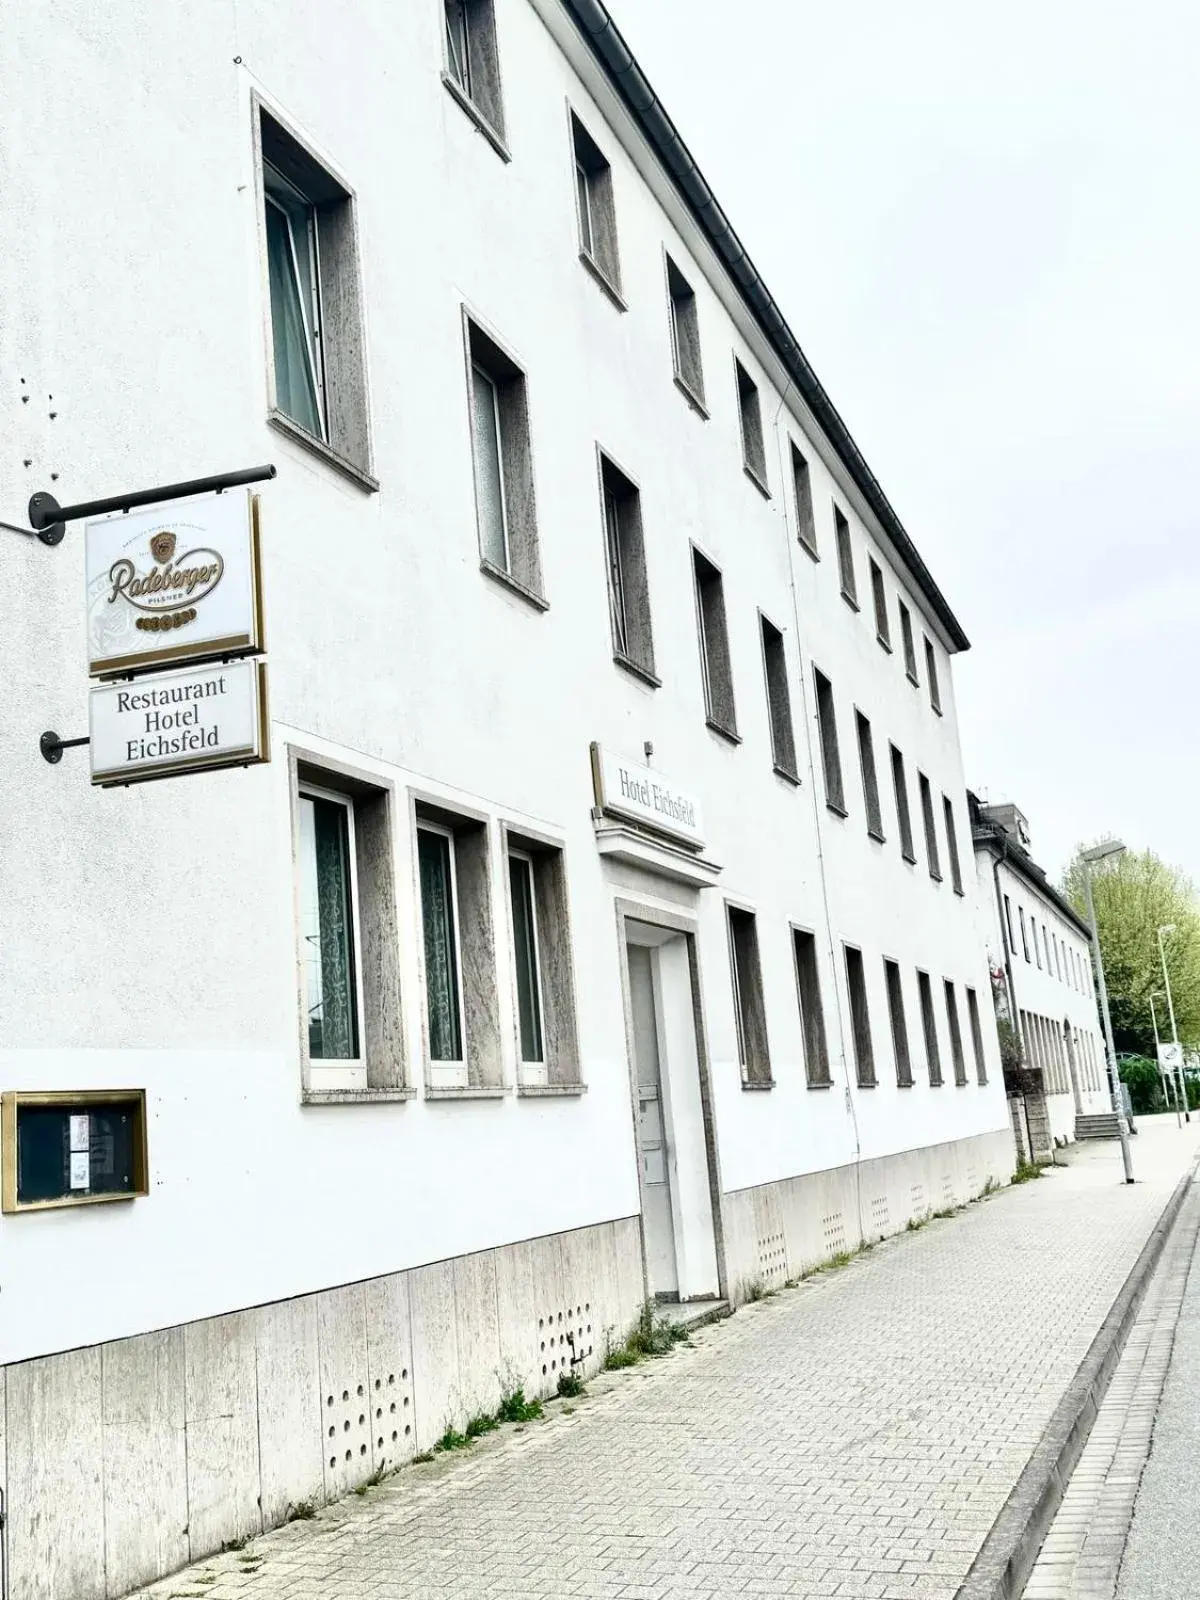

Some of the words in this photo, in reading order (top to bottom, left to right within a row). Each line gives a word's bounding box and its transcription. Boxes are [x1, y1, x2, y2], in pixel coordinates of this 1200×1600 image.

[108, 556, 220, 604] Radeberger
[148, 593, 183, 604] PILSNER
[117, 674, 226, 713] Restaurant
[144, 704, 199, 733] Hotel
[126, 725, 219, 761] Eichsfeld
[619, 768, 651, 807] Hotel
[651, 784, 696, 827] Eichsfeld
